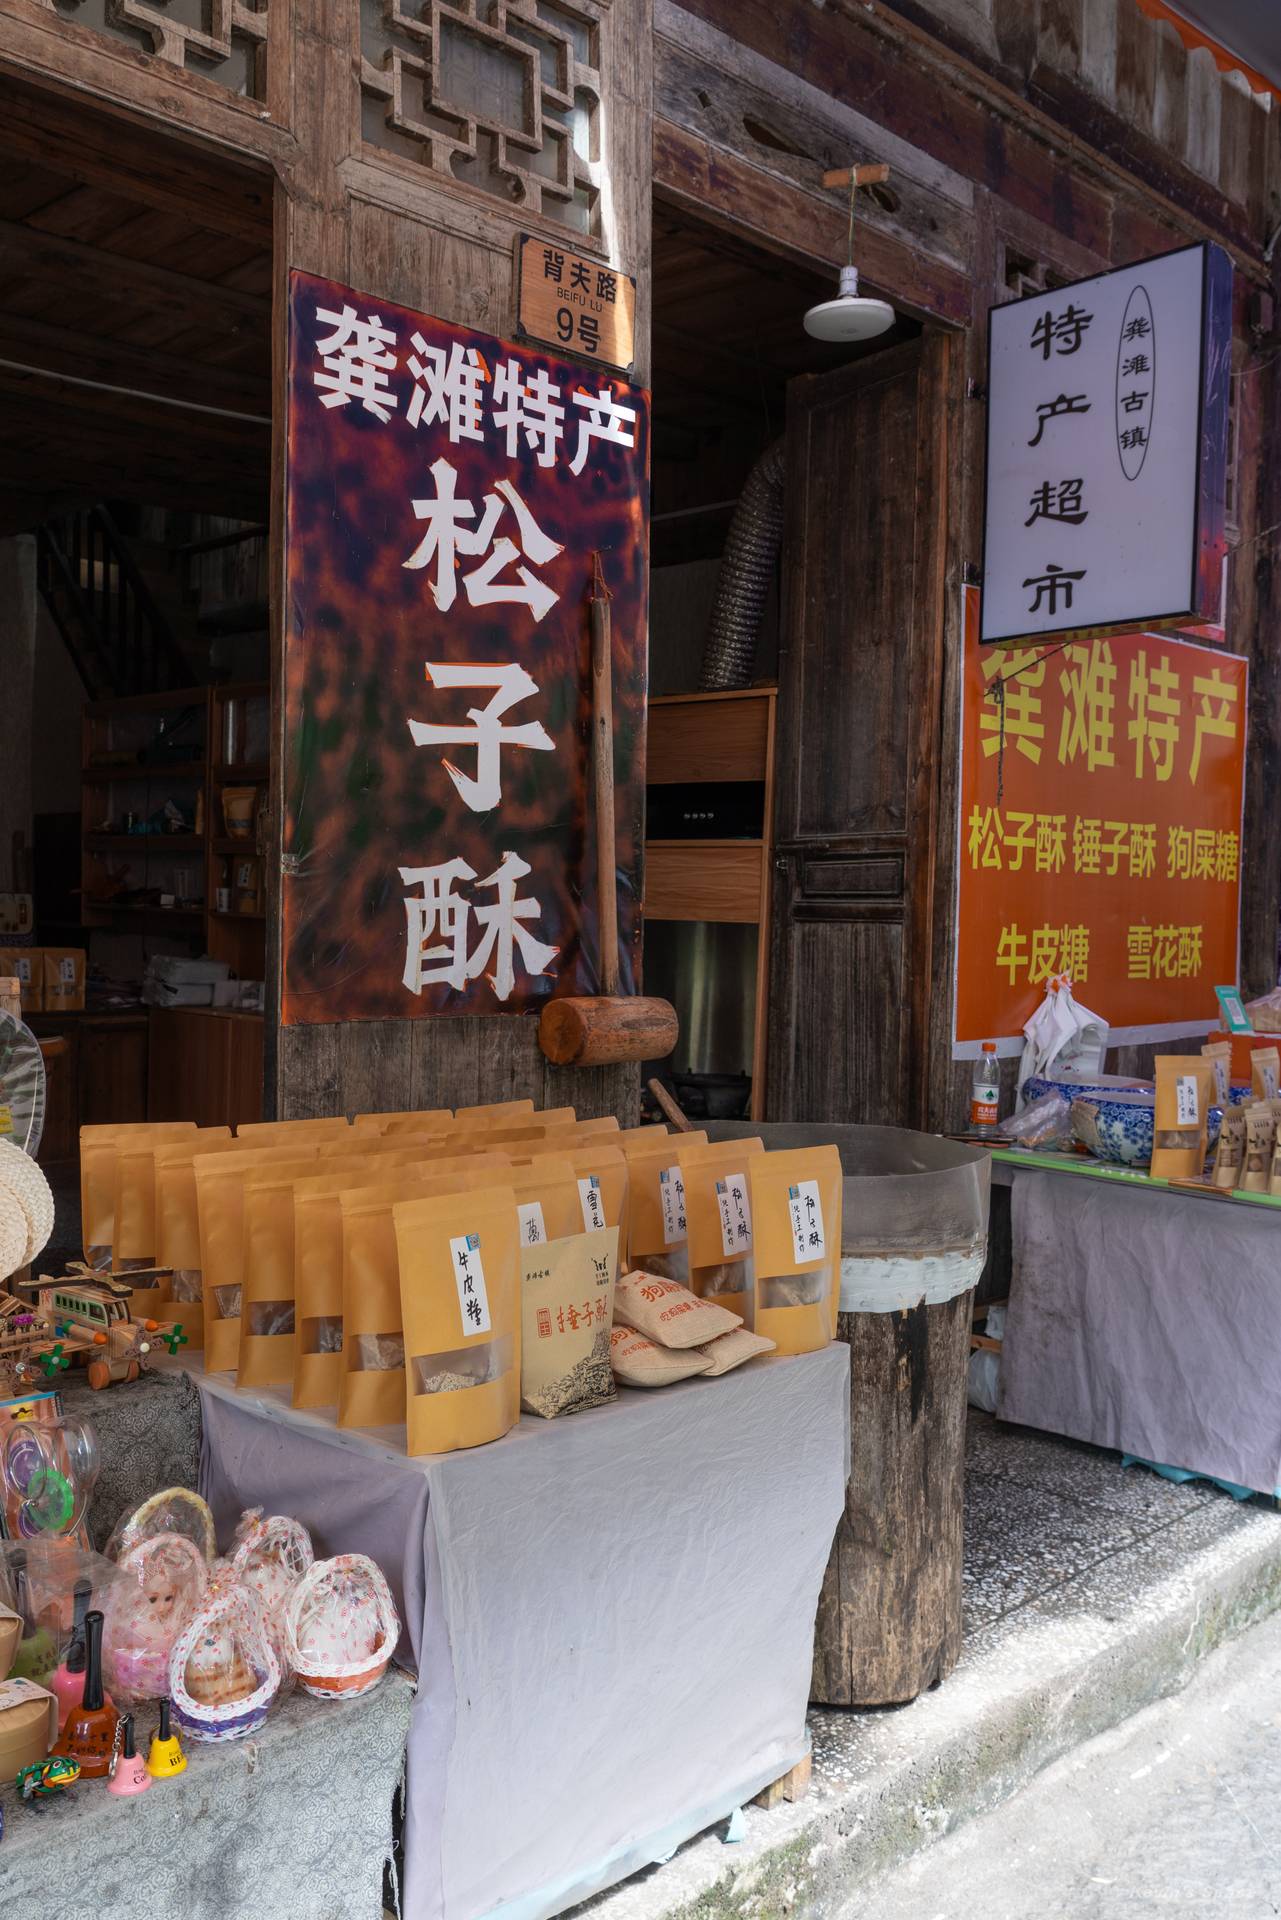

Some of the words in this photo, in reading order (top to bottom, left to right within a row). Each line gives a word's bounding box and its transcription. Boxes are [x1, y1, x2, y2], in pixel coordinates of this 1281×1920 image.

[543, 249, 617, 304] 背夫路
[557, 286, 586, 307] BEIFU
[589, 300, 603, 313] LU
[556, 307, 602, 353] 9号
[313, 304, 636, 476] 龚滩特产
[1119, 316, 1151, 449] 龚滩古镇
[1022, 304, 1094, 615] 特产超市
[398, 456, 566, 1001] 松子酥
[979, 639, 1238, 785] 龚滩特产
[968, 804, 1067, 873] 松子酥
[1072, 814, 1158, 878] 锤子酥
[1166, 824, 1239, 882] 狗屎糖
[995, 922, 1090, 986] 牛皮糖
[1126, 924, 1203, 979] 雪花酥
[133, 1773, 147, 1785] Co
[169, 1752, 184, 1767] BE
